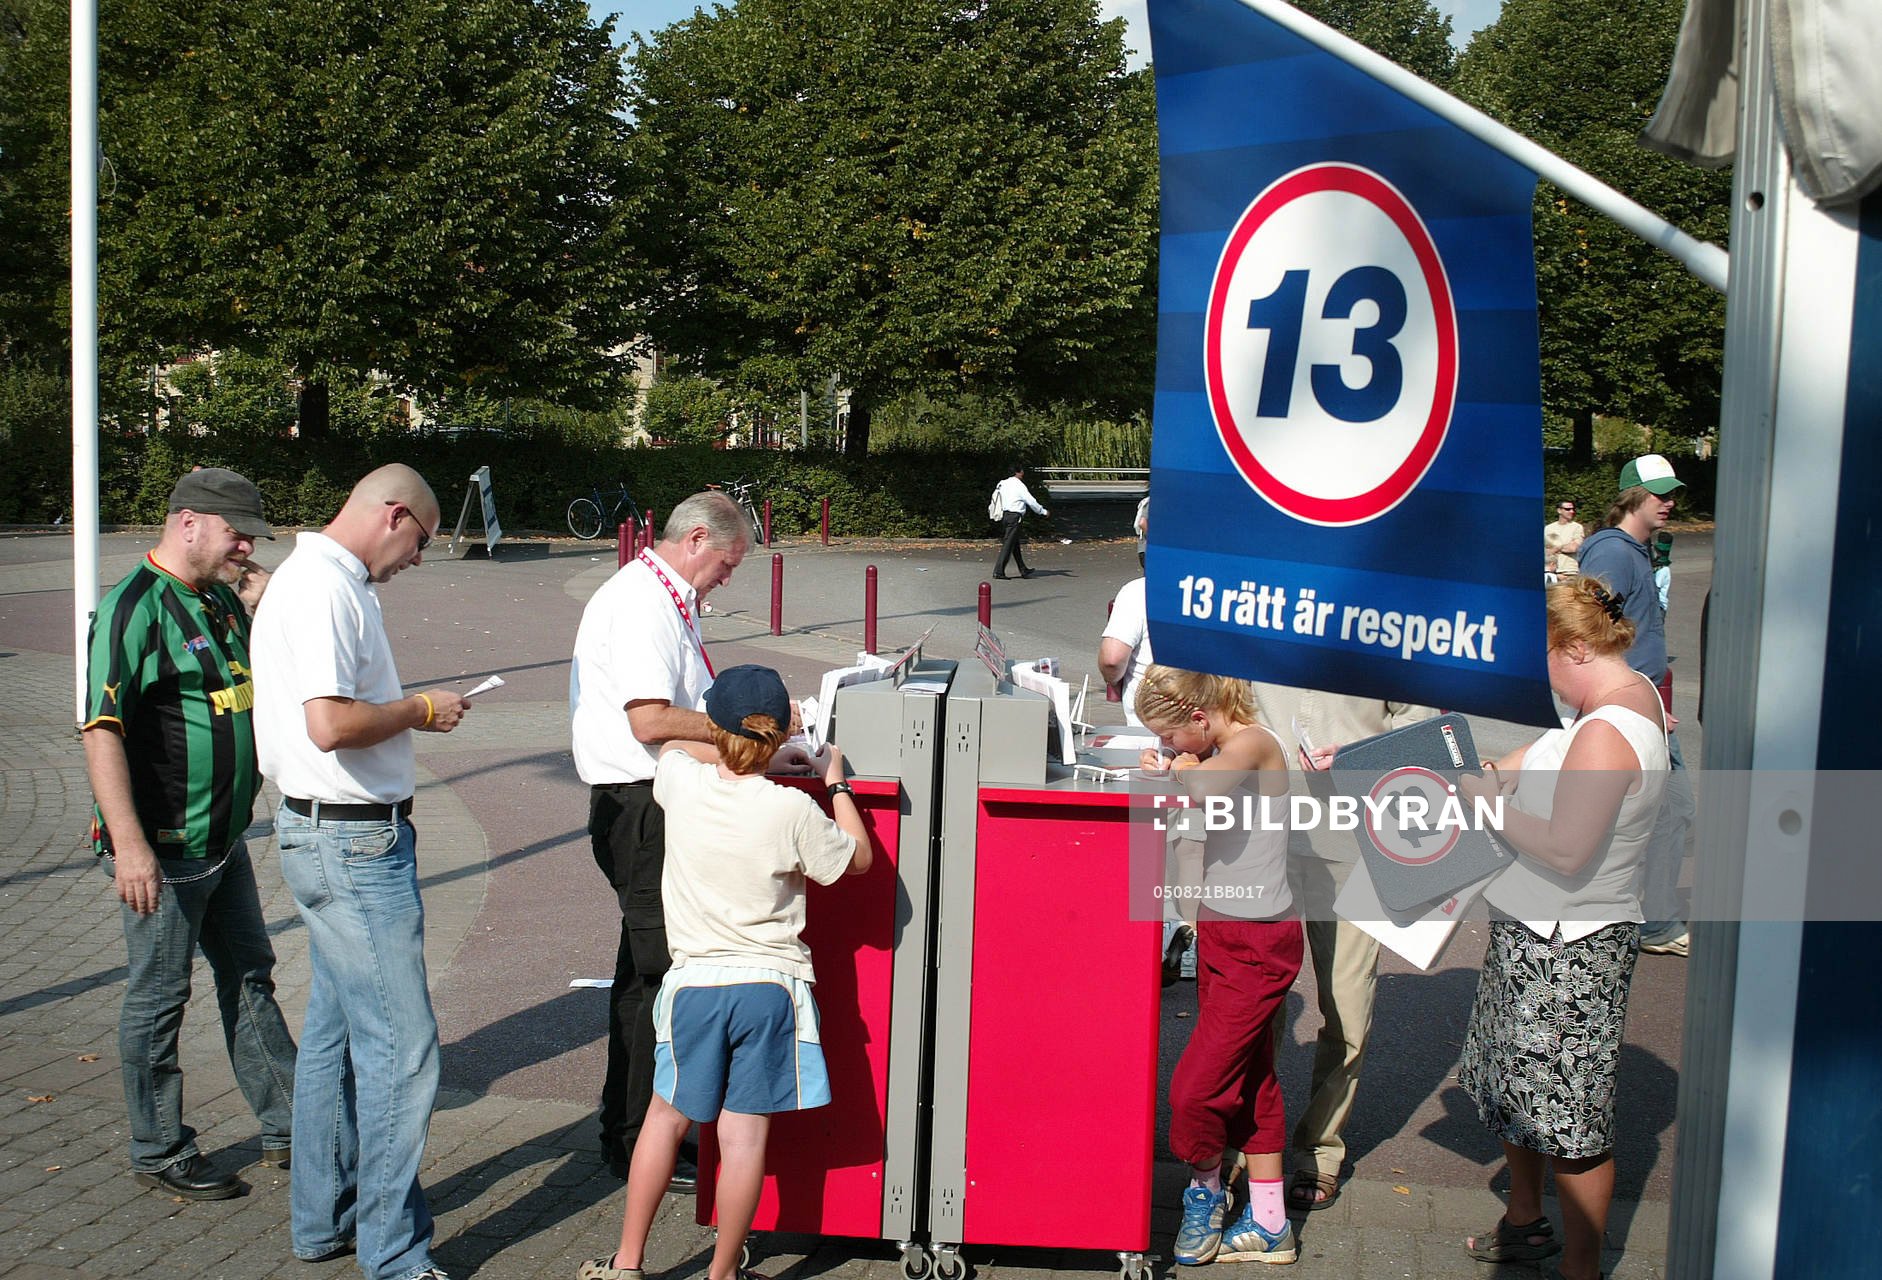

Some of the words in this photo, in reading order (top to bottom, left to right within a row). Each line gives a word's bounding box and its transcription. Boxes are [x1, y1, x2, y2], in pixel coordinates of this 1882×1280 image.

[1247, 265, 1408, 424] 13
[1178, 575, 1214, 620] 13
[1219, 580, 1287, 631] rätt
[1292, 588, 1335, 637] är
[1339, 605, 1498, 663] respekt
